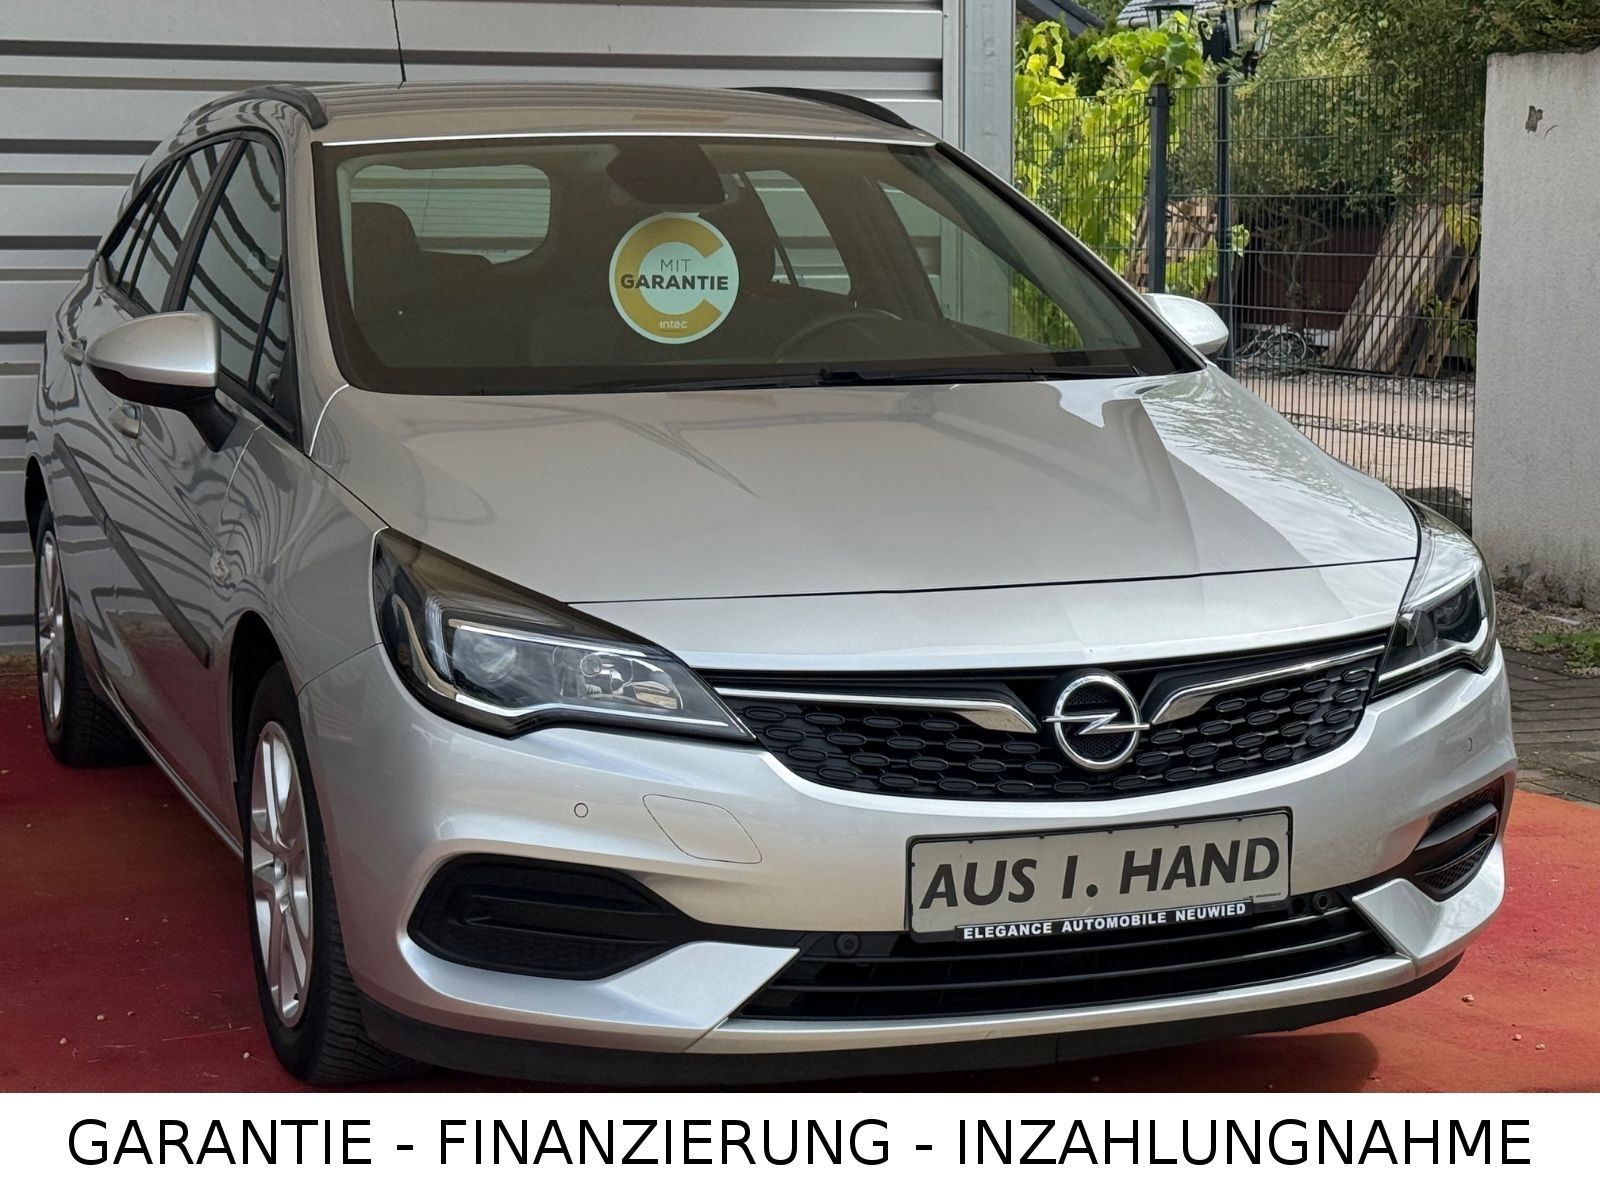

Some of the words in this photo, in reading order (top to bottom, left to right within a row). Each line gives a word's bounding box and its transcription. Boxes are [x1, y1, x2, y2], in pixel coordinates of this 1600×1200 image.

[660, 258, 692, 273] MIT
[620, 273, 729, 291] GARANTIE
[919, 858, 1038, 910] AUS
[1119, 837, 1281, 895] HAND
[963, 921, 1053, 940] ELEGANCE
[1061, 911, 1167, 933] AUTOMOBILE
[1175, 902, 1247, 922] NEUWIED
